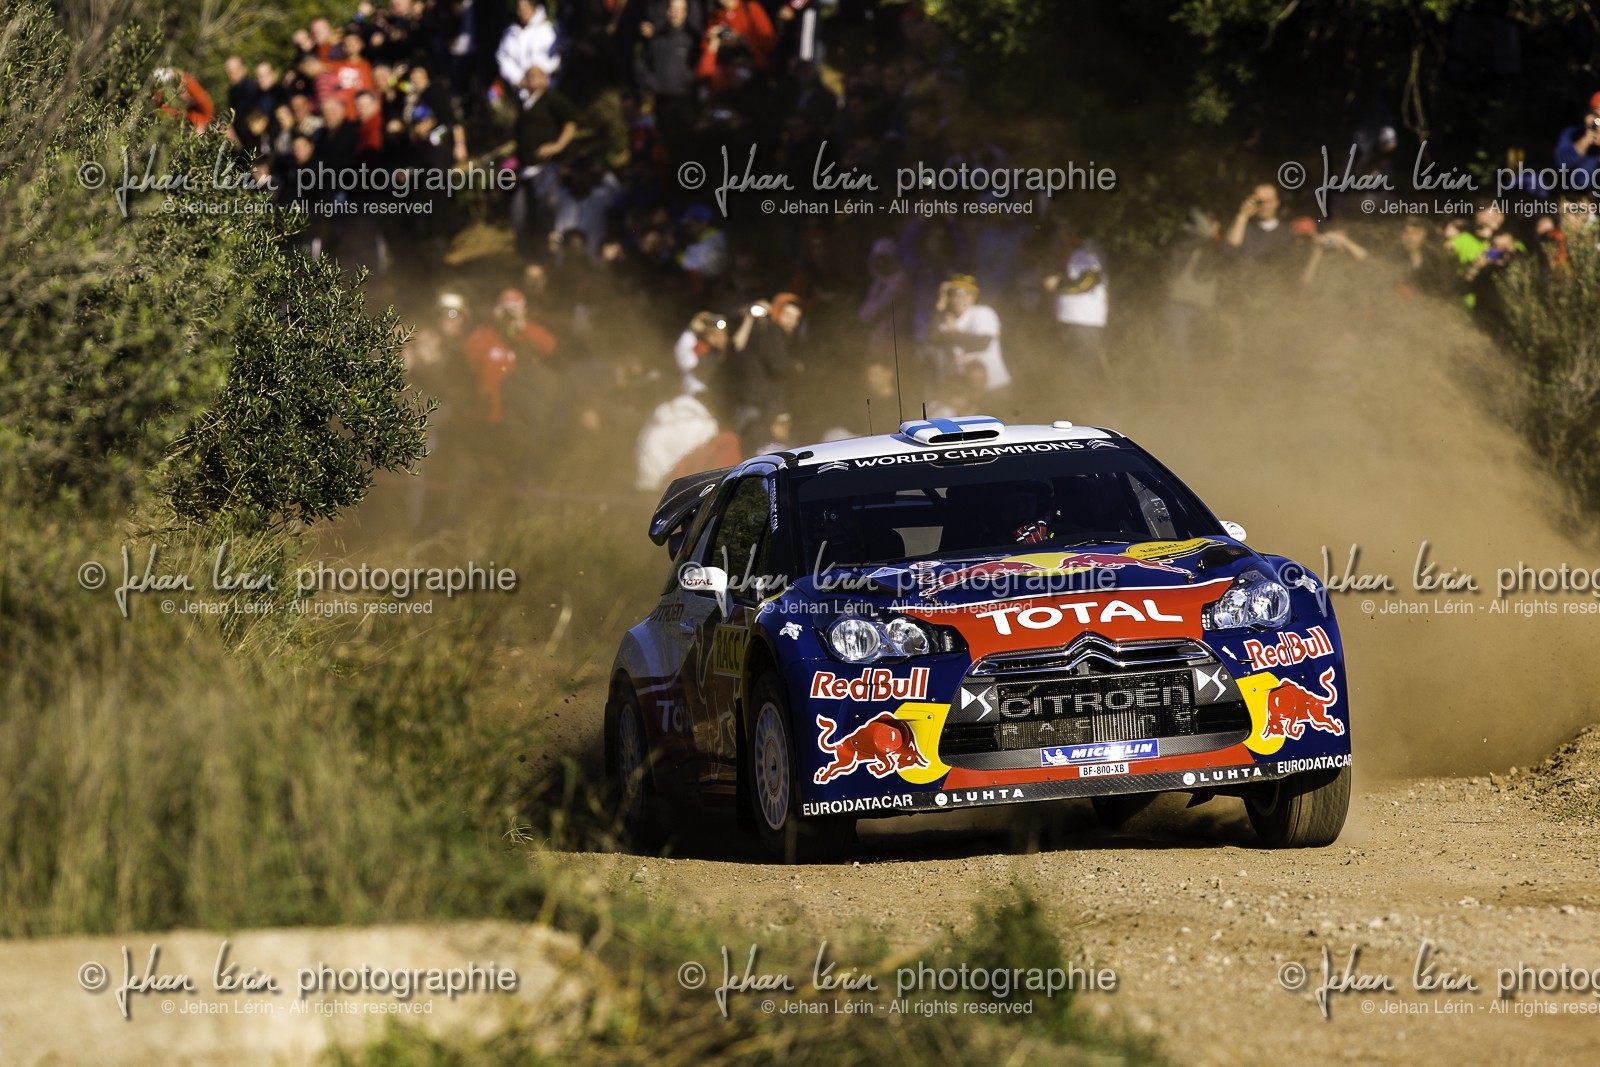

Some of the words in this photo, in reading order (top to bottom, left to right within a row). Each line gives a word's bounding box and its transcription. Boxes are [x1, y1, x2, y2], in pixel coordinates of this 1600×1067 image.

[855, 453, 939, 467] WORLD
[944, 441, 1085, 459] CHAMPIONS
[683, 578, 713, 586] TOTAL
[975, 599, 1184, 636] TOTAL
[716, 630, 742, 671] RACC
[1071, 743, 1153, 759] MICHELIN
[1083, 764, 1125, 775] BF-800-XB
[1200, 767, 1262, 782] LUHTA
[952, 788, 1024, 803] LUHTA
[803, 794, 913, 816] EURODATACAR
